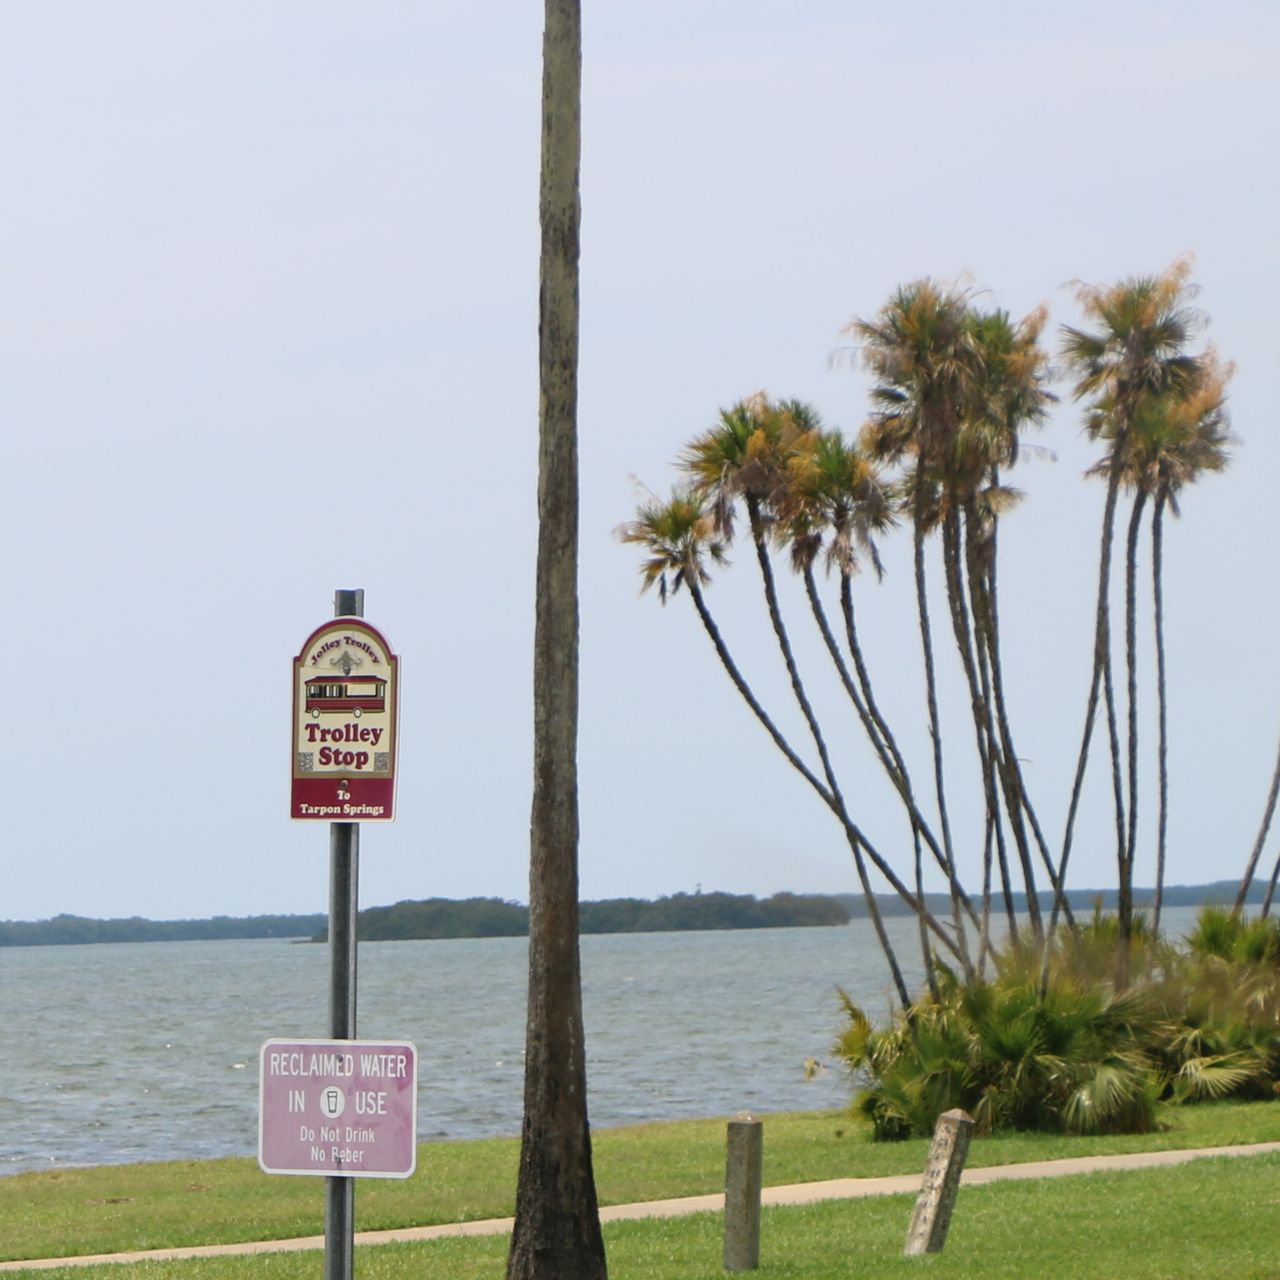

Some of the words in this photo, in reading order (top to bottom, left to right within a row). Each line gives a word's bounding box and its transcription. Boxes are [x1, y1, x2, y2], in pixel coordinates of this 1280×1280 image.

[311, 638, 341, 666] Jolley
[343, 636, 380, 664] Trolley
[305, 723, 384, 746] Trolley
[318, 747, 369, 770] Stop
[337, 790, 351, 800] To
[300, 804, 341, 816] Tarpon
[343, 802, 384, 816] Springs
[270, 1053, 353, 1076] RECLAIMED
[361, 1054, 406, 1077] WATER
[289, 1091, 305, 1112] IN
[356, 1092, 387, 1114] USE
[300, 1126, 315, 1142] Do
[321, 1127, 340, 1142] Not
[346, 1128, 375, 1143] Drink
[311, 1147, 325, 1161] No
